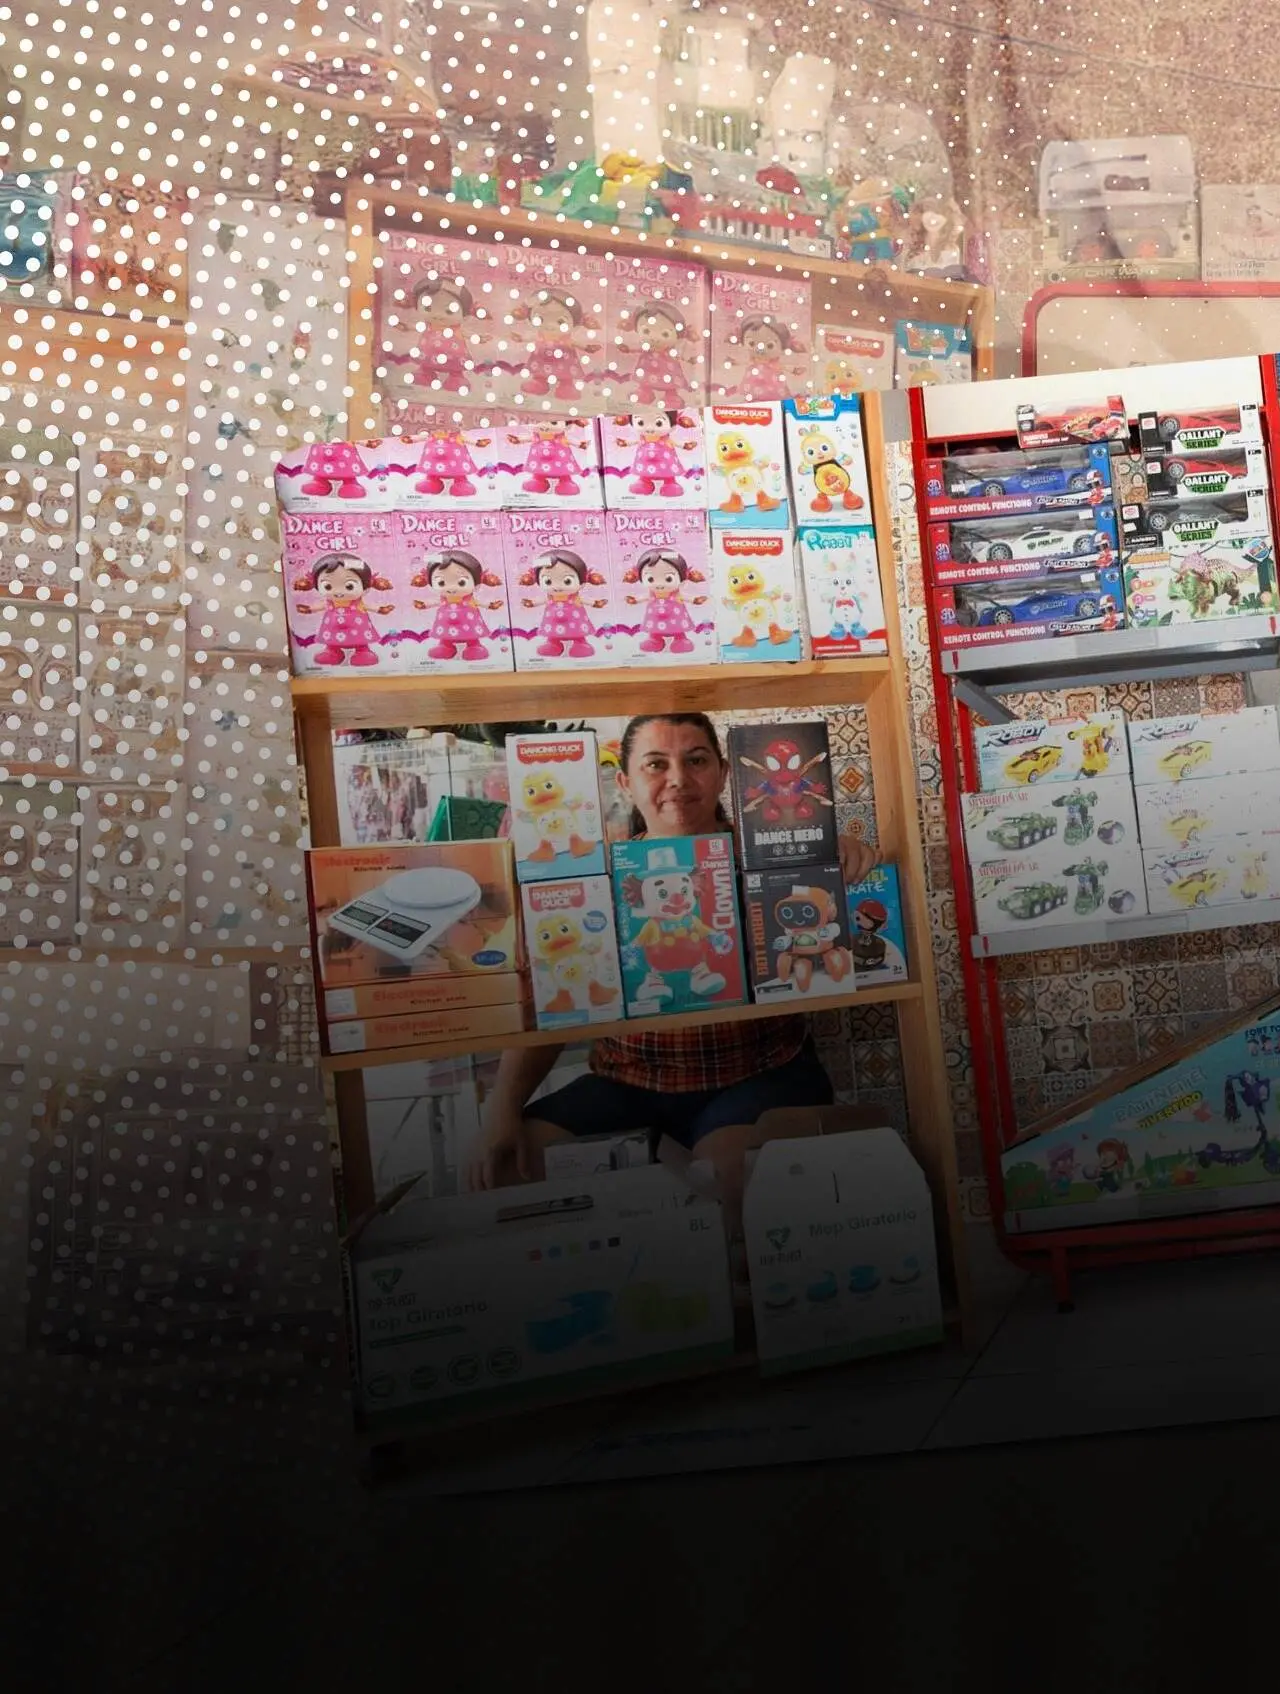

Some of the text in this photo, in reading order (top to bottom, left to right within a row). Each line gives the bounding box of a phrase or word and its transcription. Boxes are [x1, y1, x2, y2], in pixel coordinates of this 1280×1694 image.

[506, 246, 561, 271] DANCE
[715, 409, 769, 418] DANCING DUCK
[1179, 430, 1221, 441] GALLANT
[1186, 439, 1218, 449] SERIES
[1184, 474, 1226, 485] GALLANT
[1191, 483, 1224, 493] SERIES
[929, 506, 958, 516] REMOTE
[958, 502, 991, 513] CONTROL
[286, 516, 344, 535] DANCE
[401, 514, 455, 534] DANCE
[510, 514, 561, 532] DANCE
[614, 514, 663, 532] DANCE
[1173, 521, 1216, 532] GALLANT
[429, 534, 469, 548] GIRL
[536, 533, 574, 547] GIRL
[640, 532, 676, 546] GIRL
[1180, 530, 1213, 541] SERIES
[315, 537, 358, 550] GIRL
[725, 540, 759, 548] DANCING
[938, 570, 966, 580] REMOTE
[966, 567, 999, 577] CONTROL
[944, 635, 971, 645] REMOTE
[972, 631, 1005, 642] CONTROL
[982, 725, 1046, 748] ROBOT
[754, 828, 824, 846] DANCE HERO
[532, 888, 581, 902] DANCING
[712, 869, 735, 930] Clown
[1137, 1091, 1204, 1130] DIVERTIDO
